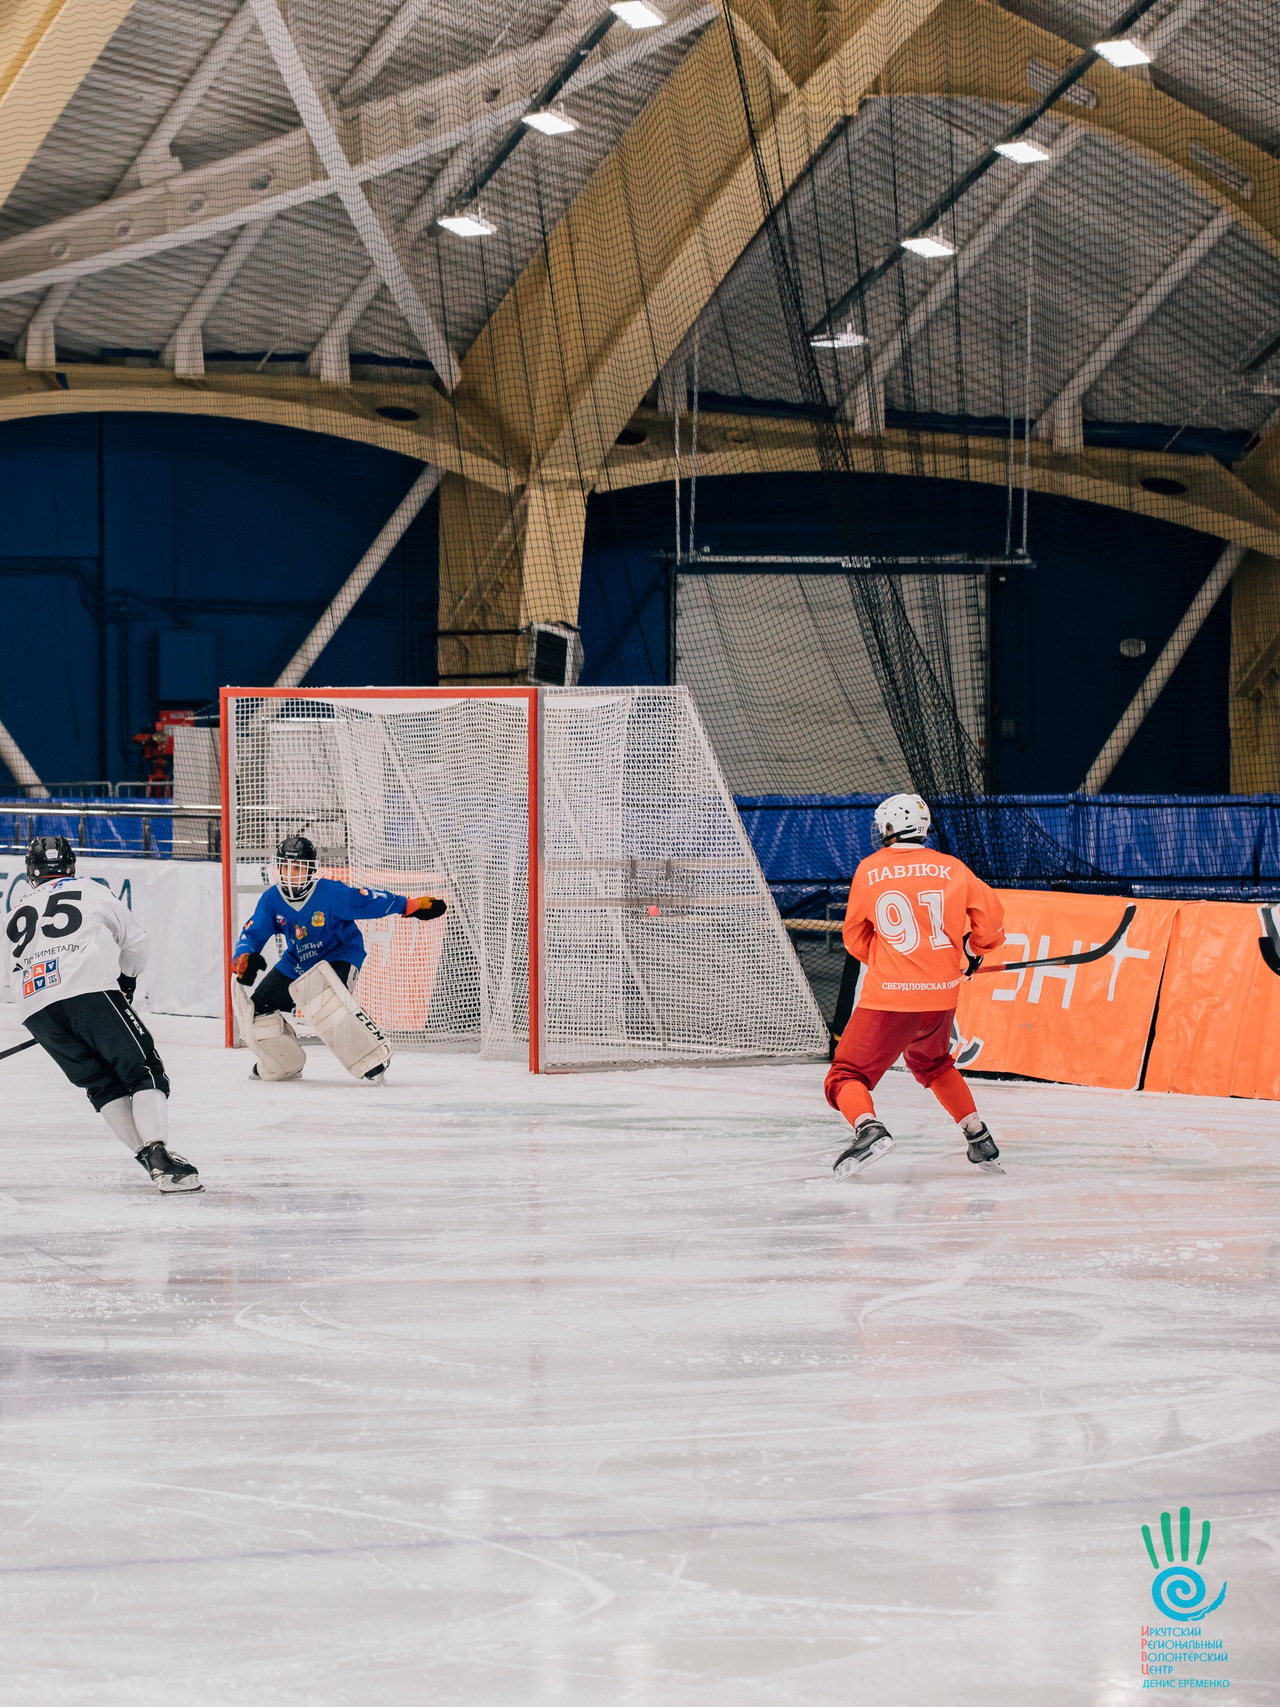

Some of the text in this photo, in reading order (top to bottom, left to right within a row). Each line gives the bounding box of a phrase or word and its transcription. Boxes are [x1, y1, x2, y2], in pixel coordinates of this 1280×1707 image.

[867, 863, 952, 886] ПАВЛЮК
[6, 890, 83, 958] 95
[875, 890, 953, 956] 91
[881, 982, 947, 991] СВЕРДЛОВСКАЯ
[355, 1011, 384, 1041] CCM
